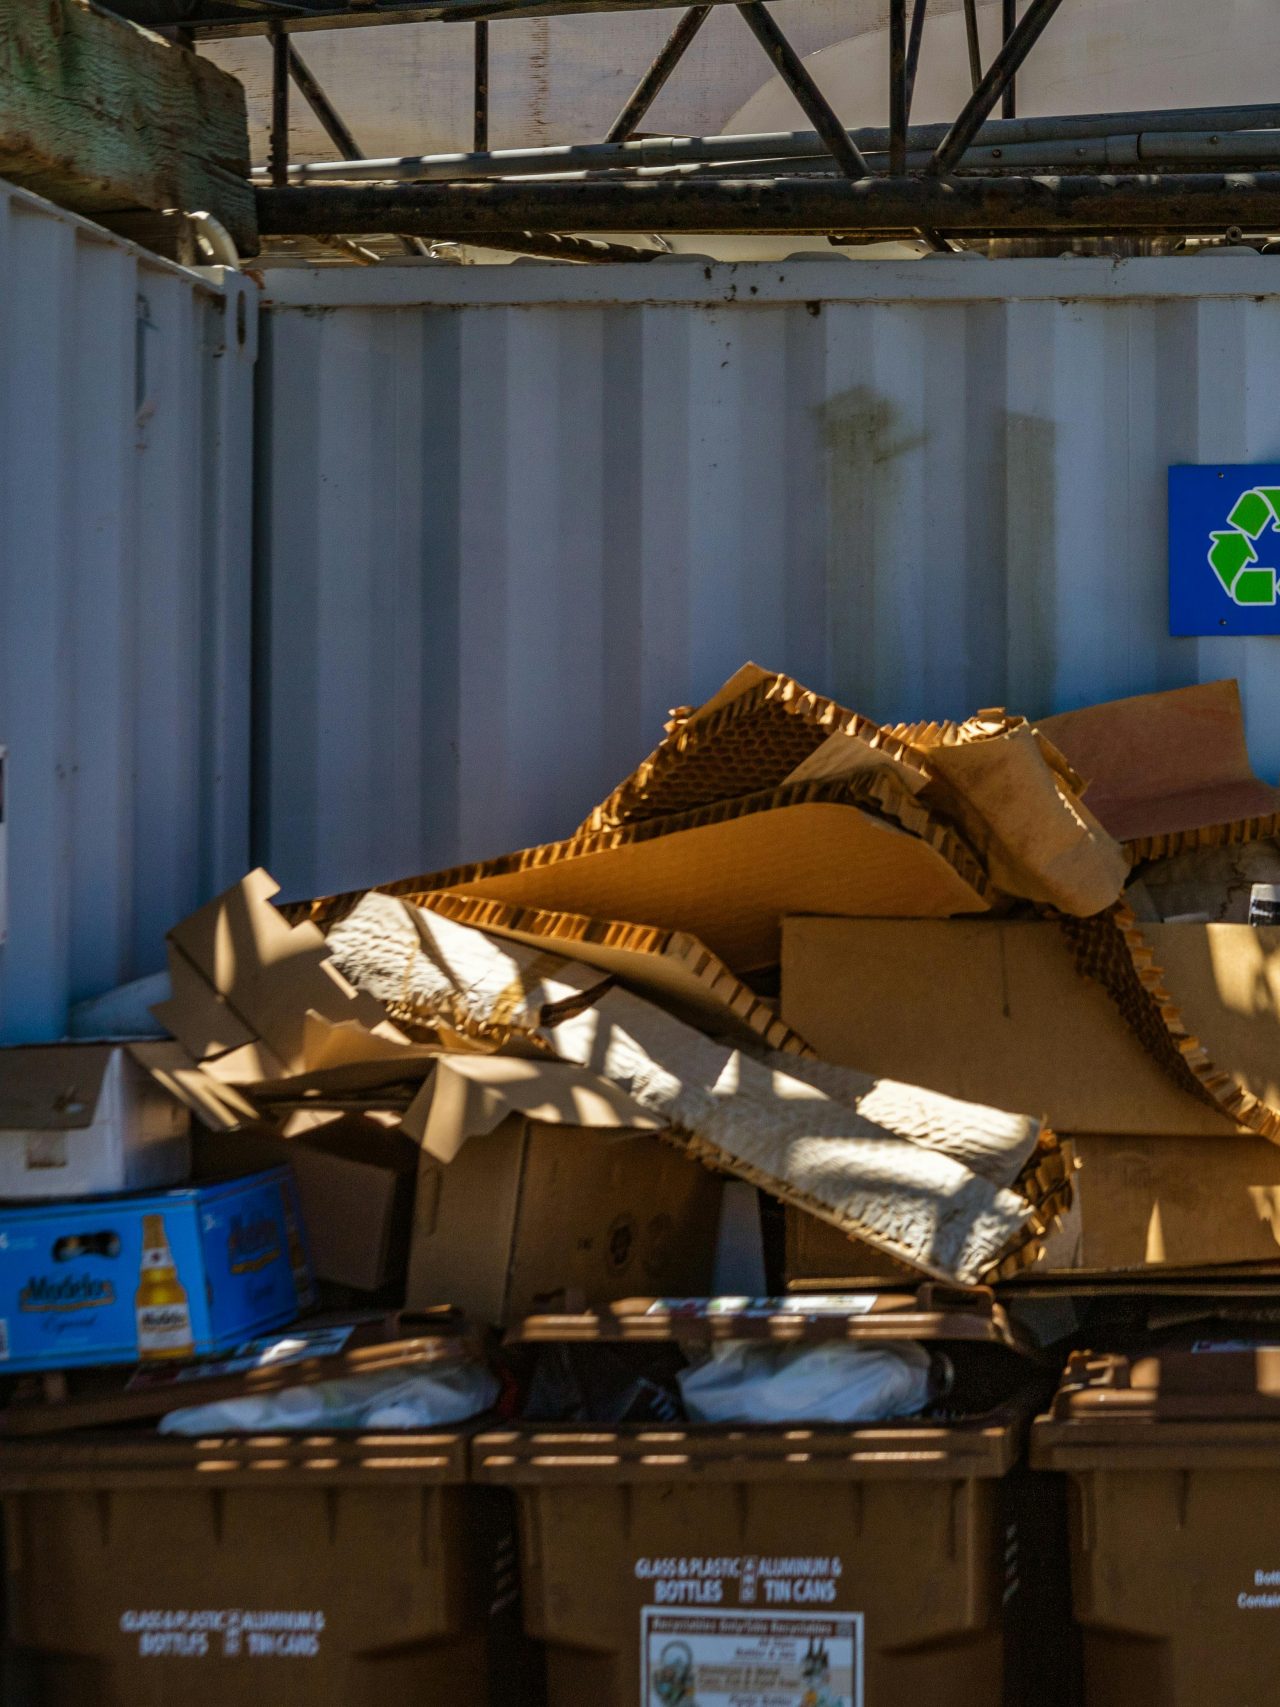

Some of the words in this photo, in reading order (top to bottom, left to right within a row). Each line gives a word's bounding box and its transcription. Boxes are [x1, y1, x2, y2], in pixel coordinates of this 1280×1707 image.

[654, 1579, 723, 1602] BOTTLES
[764, 1580, 792, 1602] TIN
[793, 1579, 836, 1602] CANS
